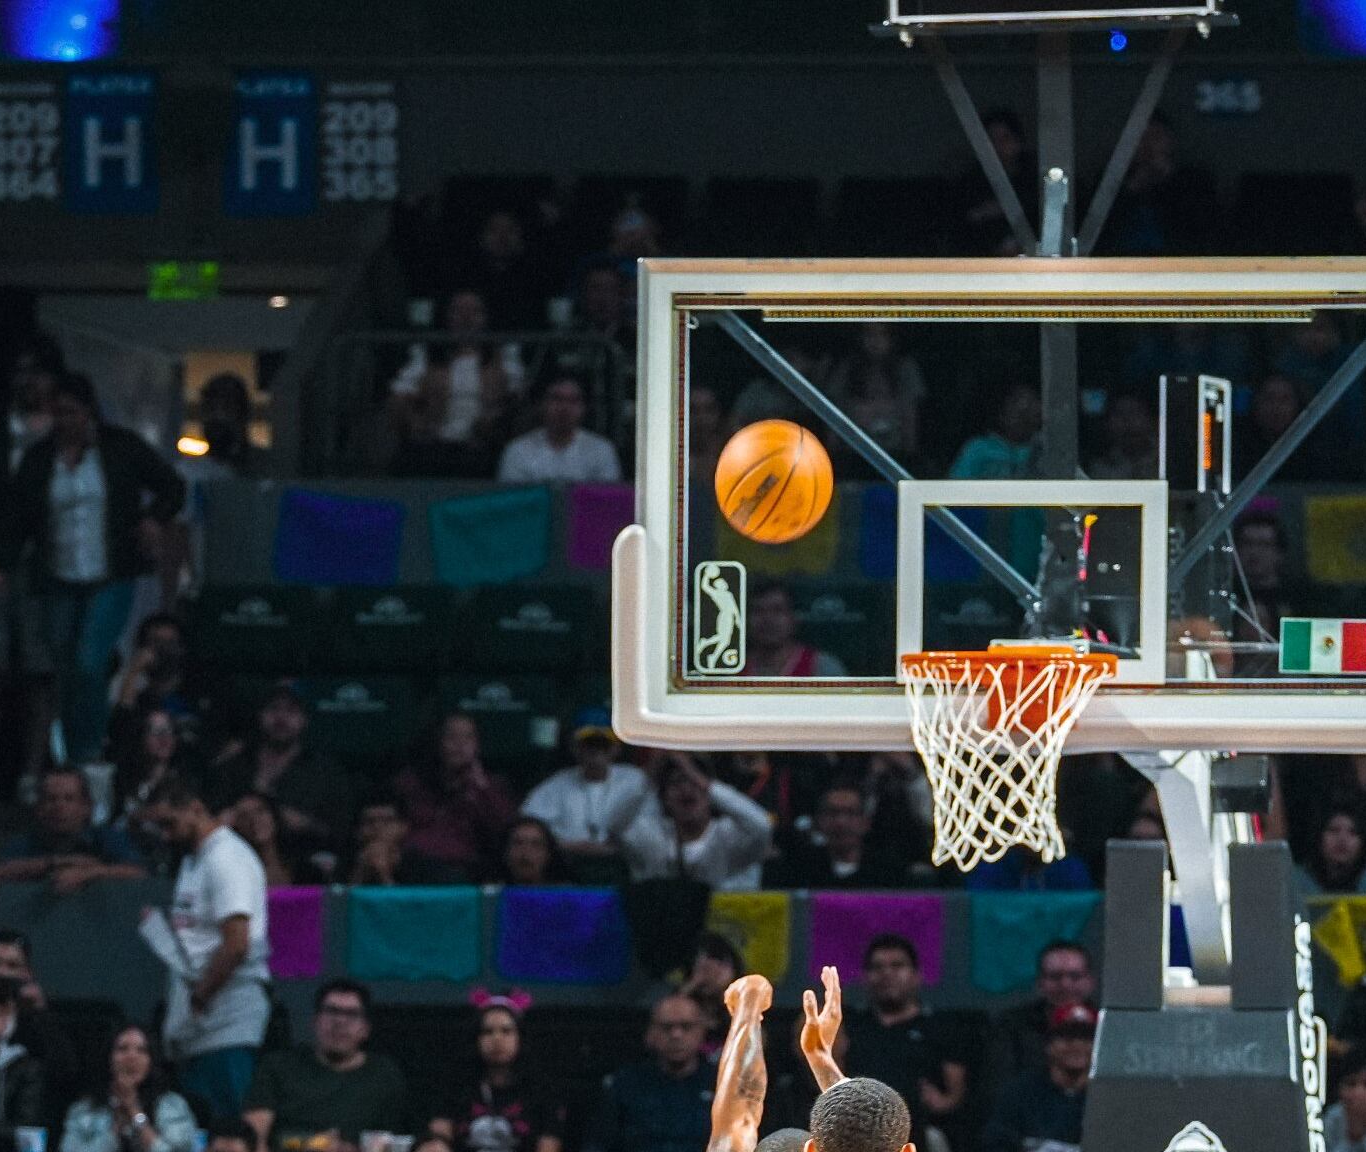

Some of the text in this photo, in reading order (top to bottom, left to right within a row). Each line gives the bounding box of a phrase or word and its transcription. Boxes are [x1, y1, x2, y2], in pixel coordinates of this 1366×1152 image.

[324, 100, 399, 132] 209
[82, 115, 142, 188] H
[239, 116, 298, 191] H
[324, 135, 399, 165] 308
[324, 167, 399, 200] 365
